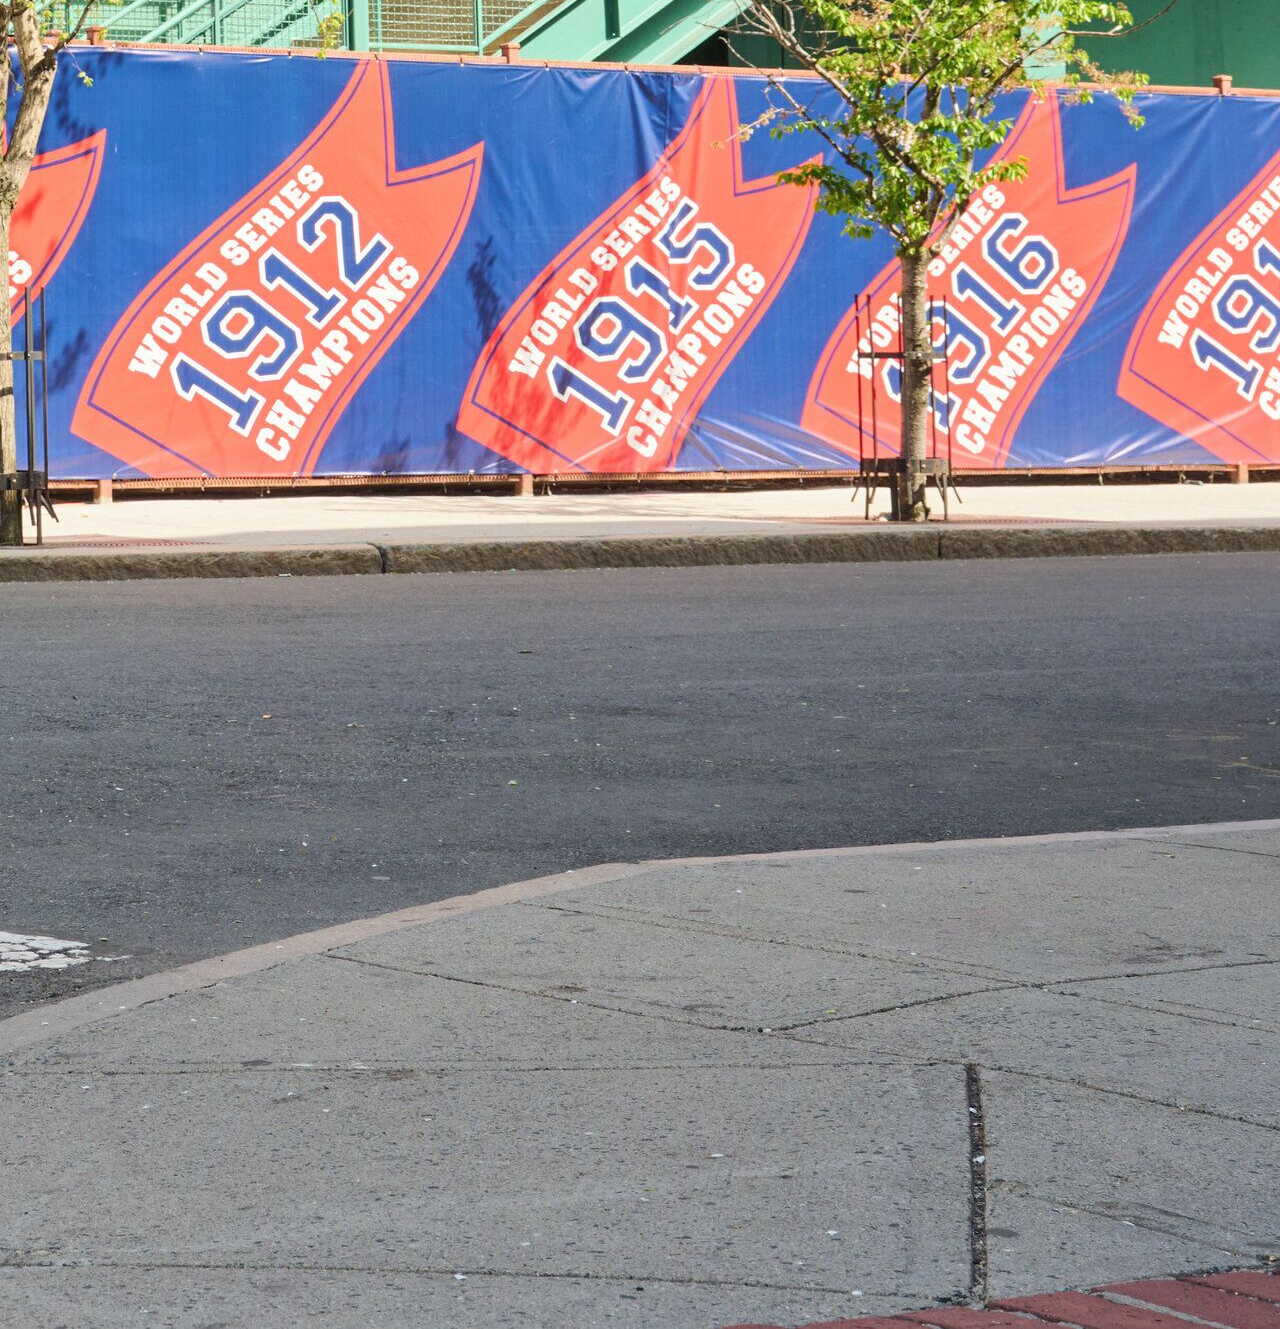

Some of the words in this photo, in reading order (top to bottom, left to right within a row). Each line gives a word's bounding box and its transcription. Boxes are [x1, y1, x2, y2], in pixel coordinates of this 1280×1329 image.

[127, 262, 228, 379] WORLD
[219, 164, 325, 266] SERIES
[169, 195, 394, 438] 1912
[508, 267, 598, 379] WORLD
[590, 176, 681, 271] SERIES
[546, 196, 736, 437] 1915
[927, 184, 1007, 277] SERIES
[1157, 247, 1234, 349] WORLD
[255, 257, 419, 462] CHAMPIONS
[626, 263, 766, 458] CHAMPIONS
[955, 267, 1088, 455] CHAMPIONS
